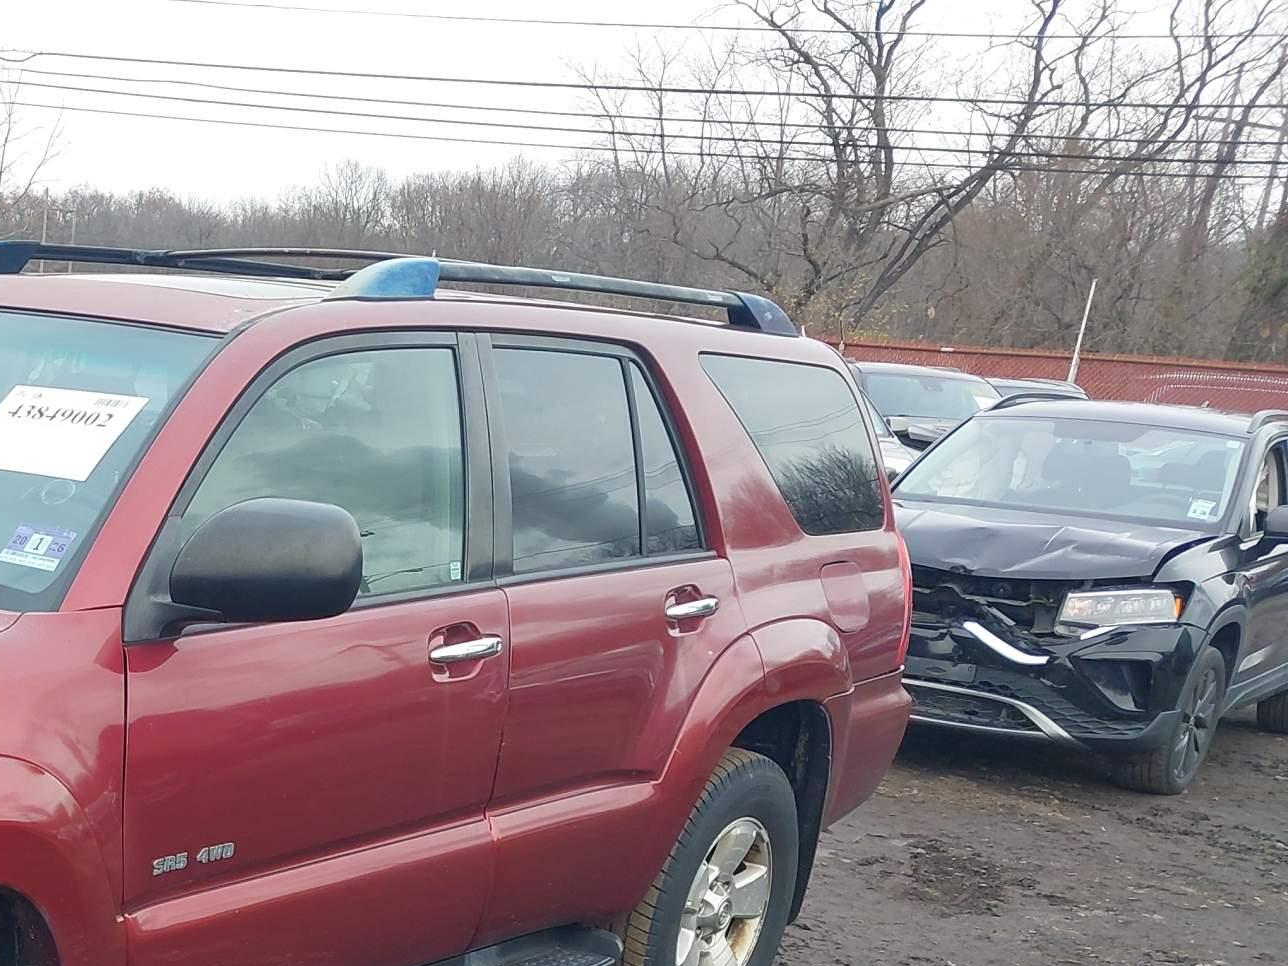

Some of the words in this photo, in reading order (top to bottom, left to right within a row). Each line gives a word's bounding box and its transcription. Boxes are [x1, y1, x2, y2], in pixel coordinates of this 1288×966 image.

[8, 404, 114, 427] 43849002
[12, 534, 28, 545] 20
[32, 537, 45, 551] 1
[49, 542, 67, 553] 26
[152, 851, 189, 876] SR5
[196, 842, 235, 864] 4WD
